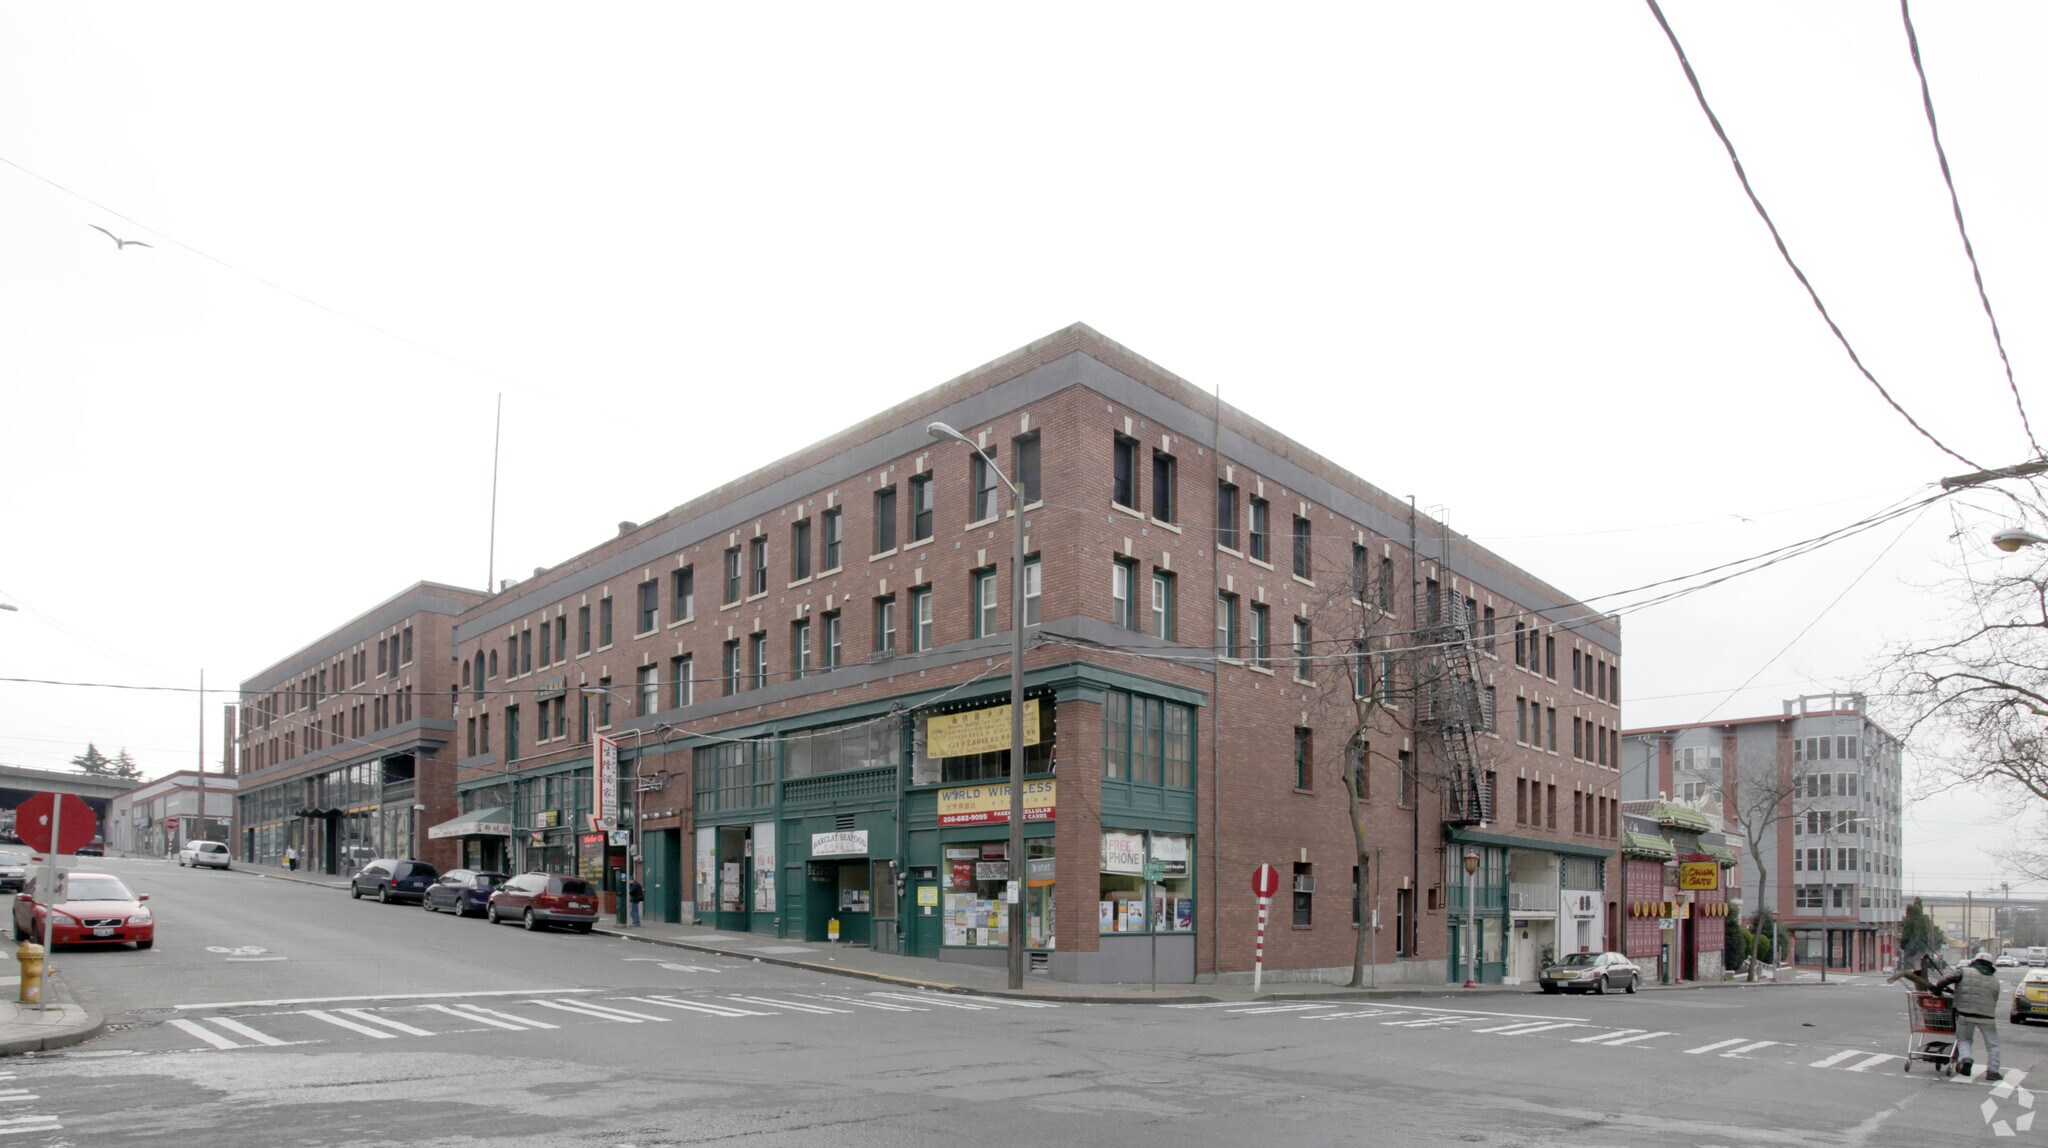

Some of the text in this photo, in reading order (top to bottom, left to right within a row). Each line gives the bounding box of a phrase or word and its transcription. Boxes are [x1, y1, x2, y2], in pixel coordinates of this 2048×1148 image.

[942, 788, 980, 801] WORLD
[813, 833, 867, 849] BARCLAY SEAFOOD
[1108, 839, 1132, 852] FREE
[1108, 852, 1139, 865] PHONE
